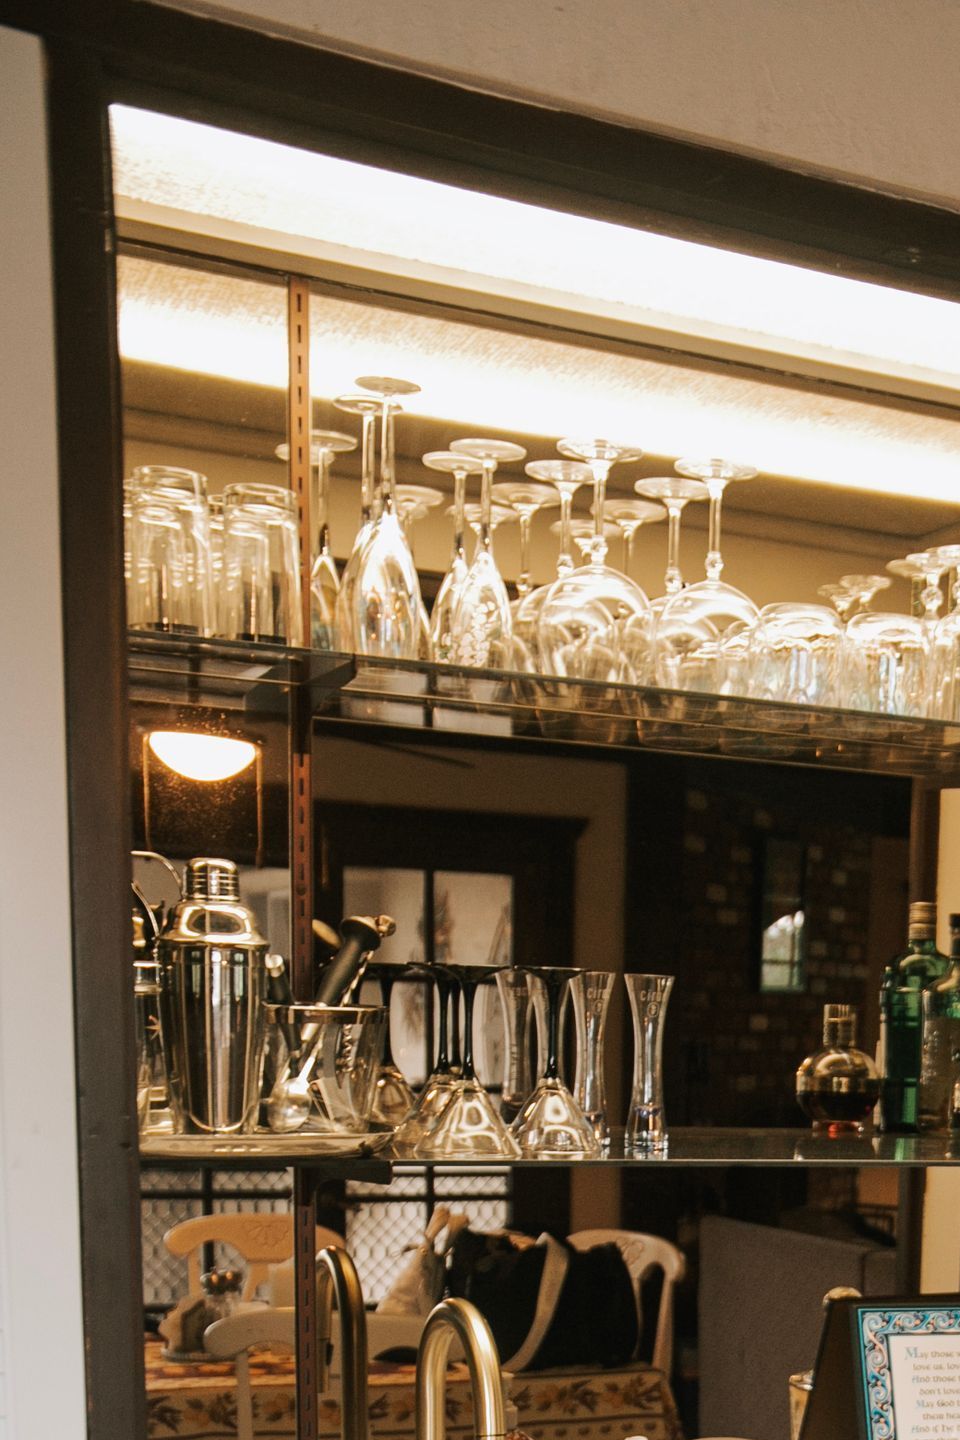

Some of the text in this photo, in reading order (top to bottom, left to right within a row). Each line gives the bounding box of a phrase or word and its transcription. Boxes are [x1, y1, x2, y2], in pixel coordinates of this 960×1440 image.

[904, 1347, 929, 1361] May
[931, 1351, 955, 1359] those
[912, 1363, 931, 1371] love
[912, 1375, 931, 1384] And
[943, 1387, 960, 1395] love
[916, 1399, 934, 1409] May
[936, 1399, 955, 1408] God
[922, 1412, 944, 1420] their
[912, 1424, 930, 1434] And
[932, 1425, 939, 1433] if
